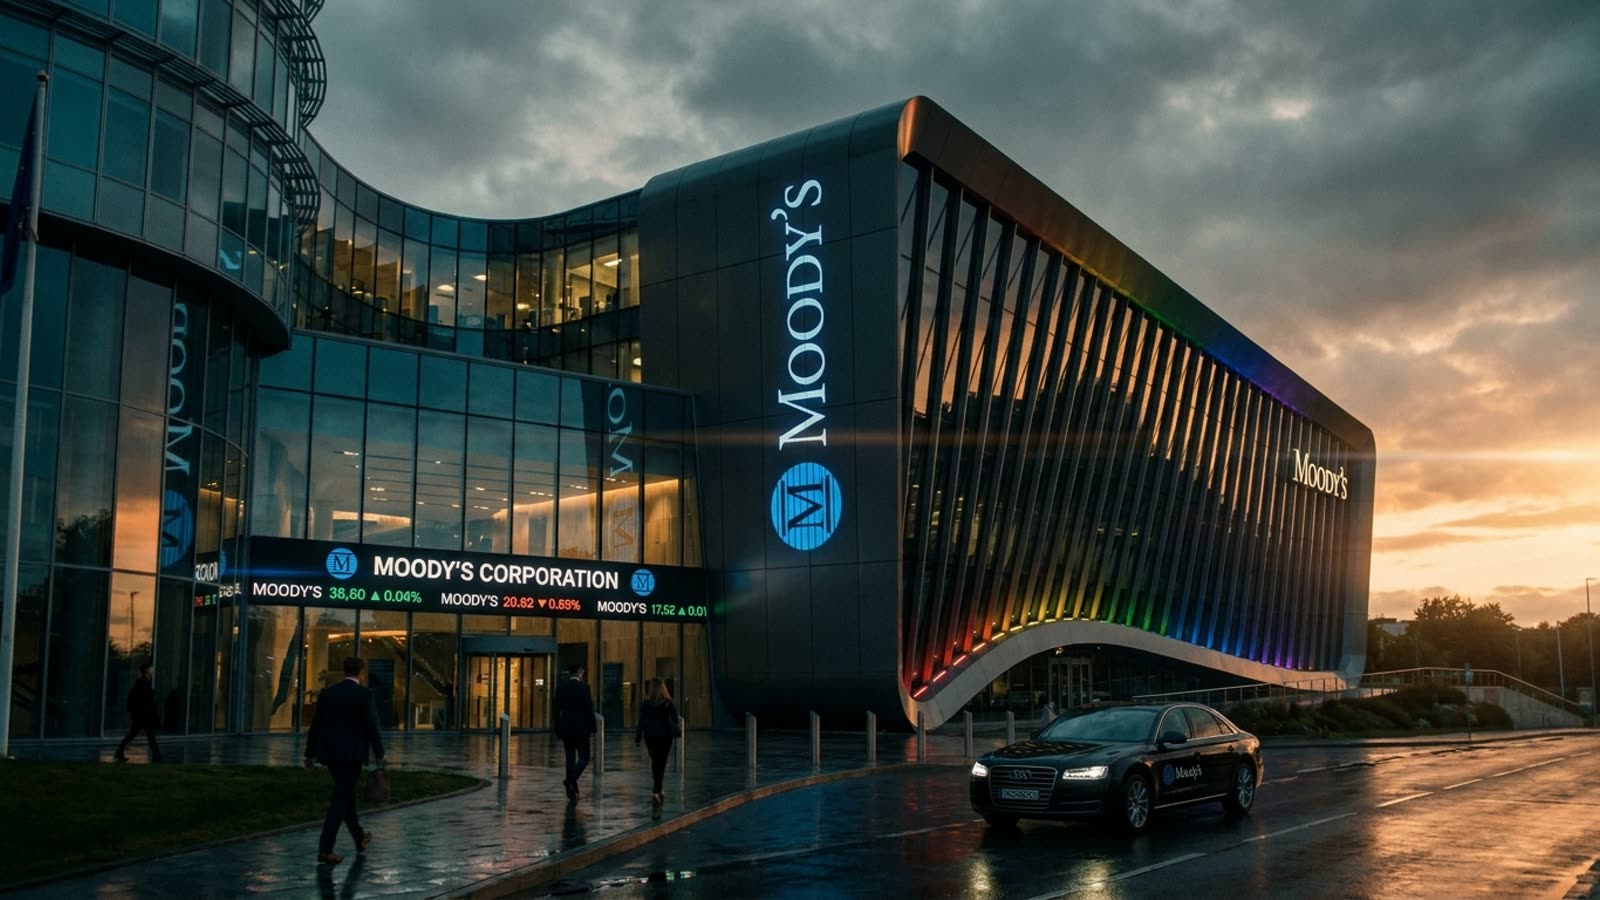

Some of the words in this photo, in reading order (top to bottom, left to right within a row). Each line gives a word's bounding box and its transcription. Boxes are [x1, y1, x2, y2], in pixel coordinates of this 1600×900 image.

[373, 556, 474, 581] MOODY'S
[479, 563, 619, 589] CORPORATION
[253, 582, 322, 598] MOODY'S
[441, 593, 498, 608] MOODY'S
[597, 601, 647, 614] MOODY'S
